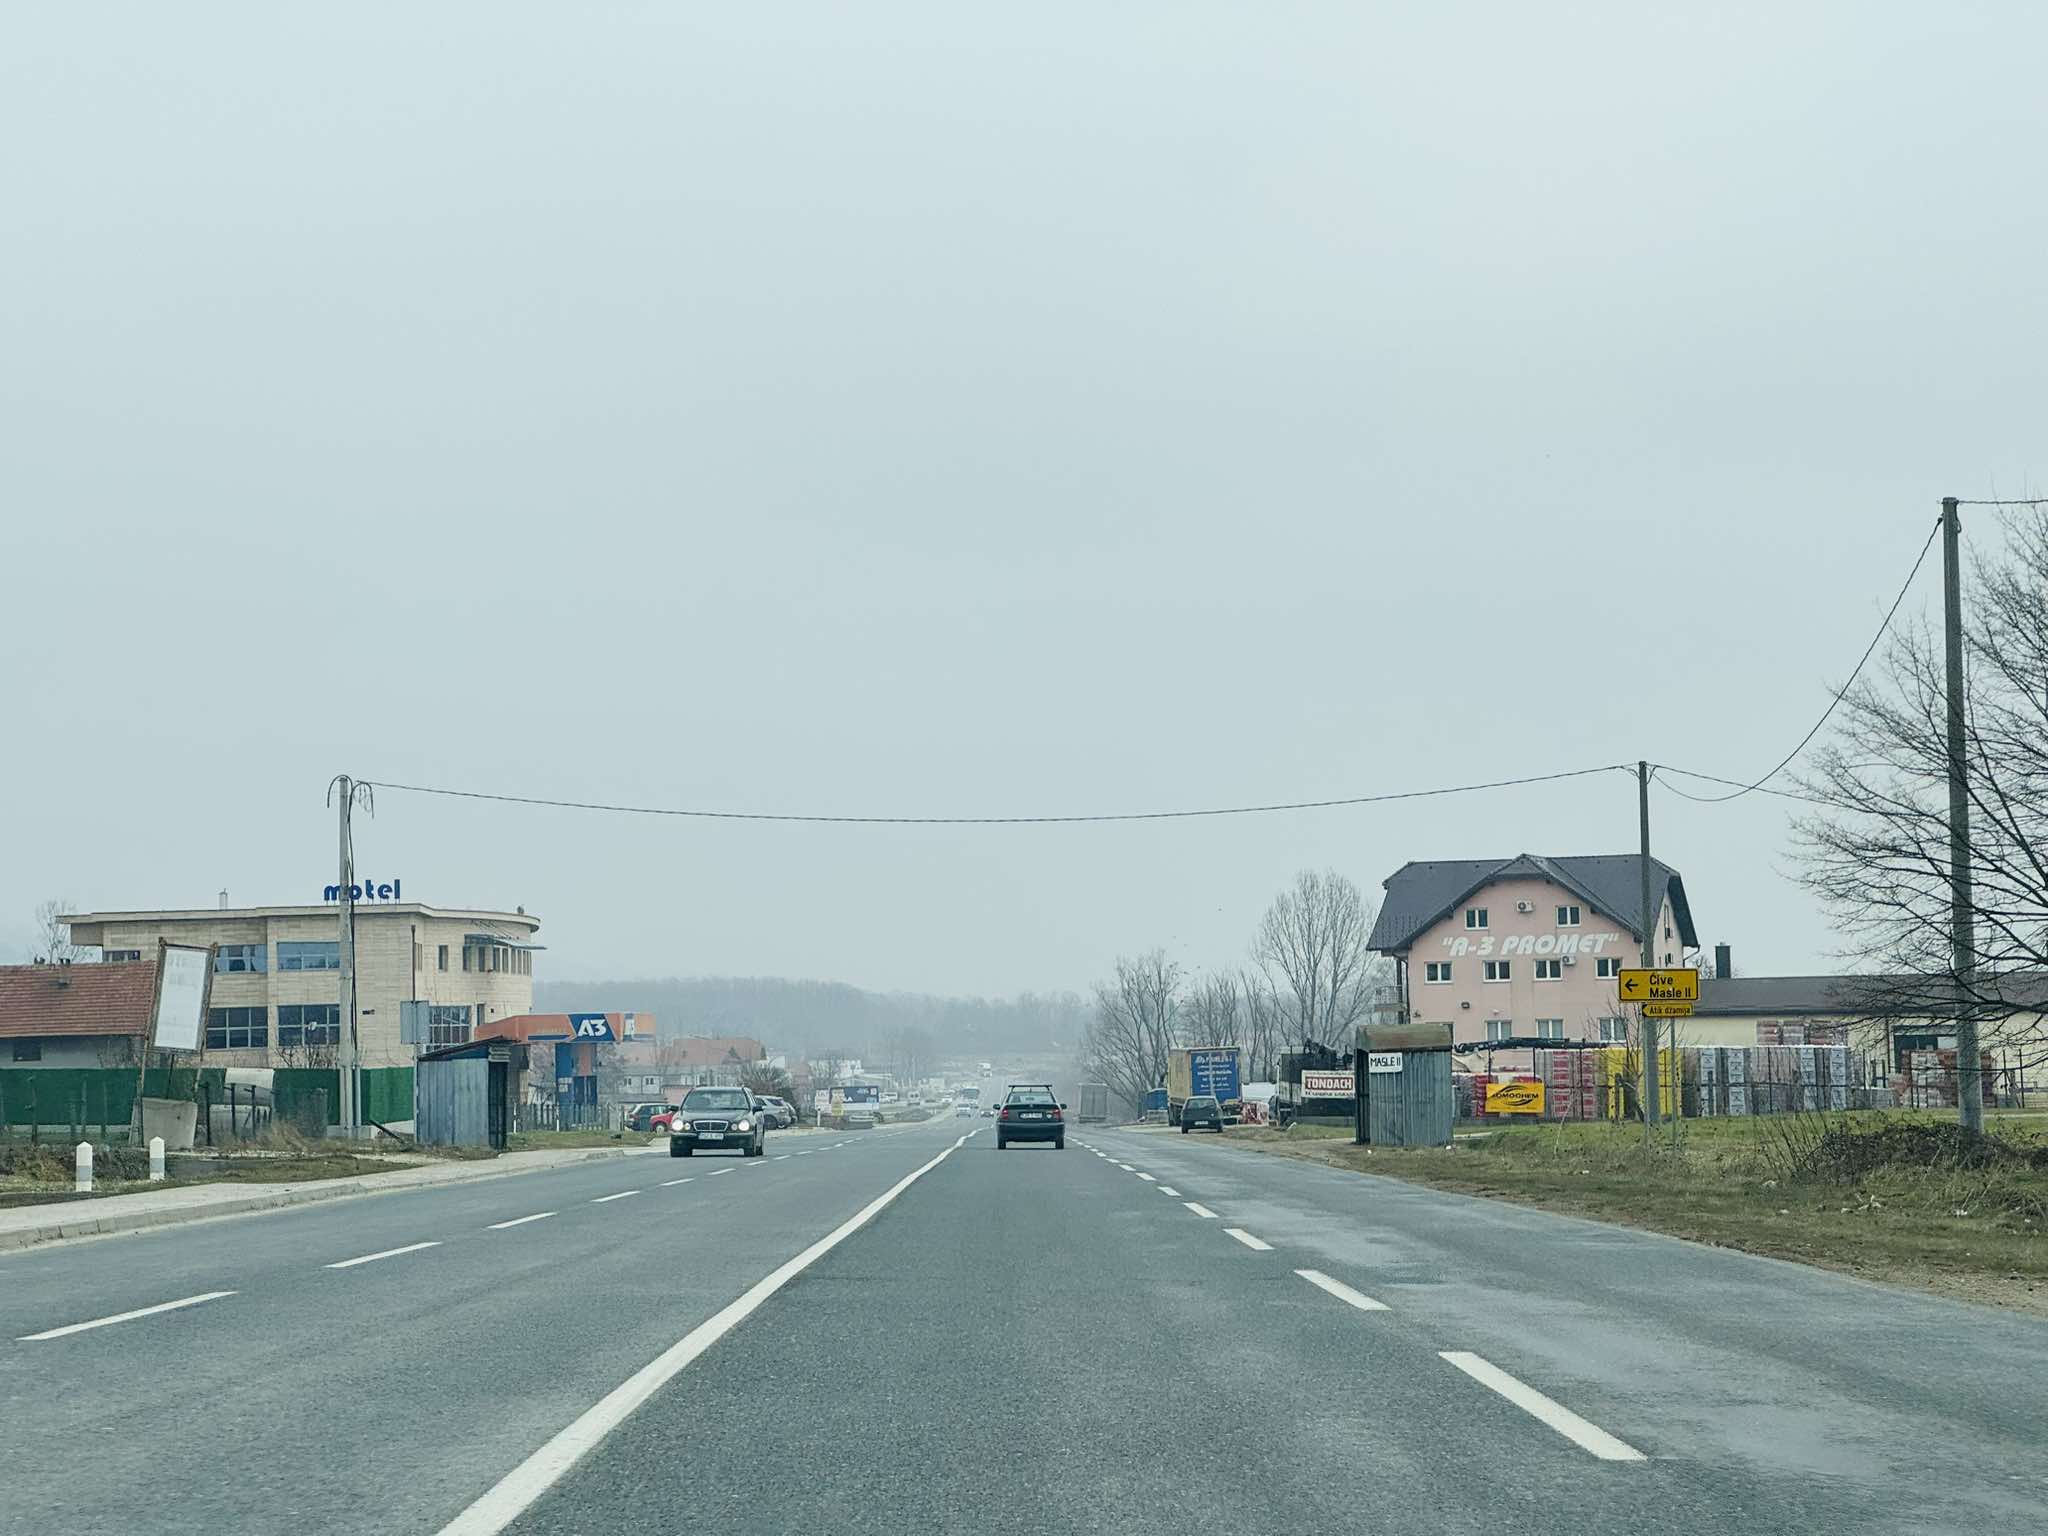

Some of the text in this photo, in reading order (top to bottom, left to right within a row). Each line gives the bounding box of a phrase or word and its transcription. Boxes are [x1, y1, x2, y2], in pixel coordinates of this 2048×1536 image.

[324, 879, 401, 901] motel
[1649, 986, 1692, 998] Masle II
[577, 1018, 607, 1037] A3
[1370, 1056, 1395, 1067] MASLE
[1306, 1077, 1352, 1089] TONDACH
